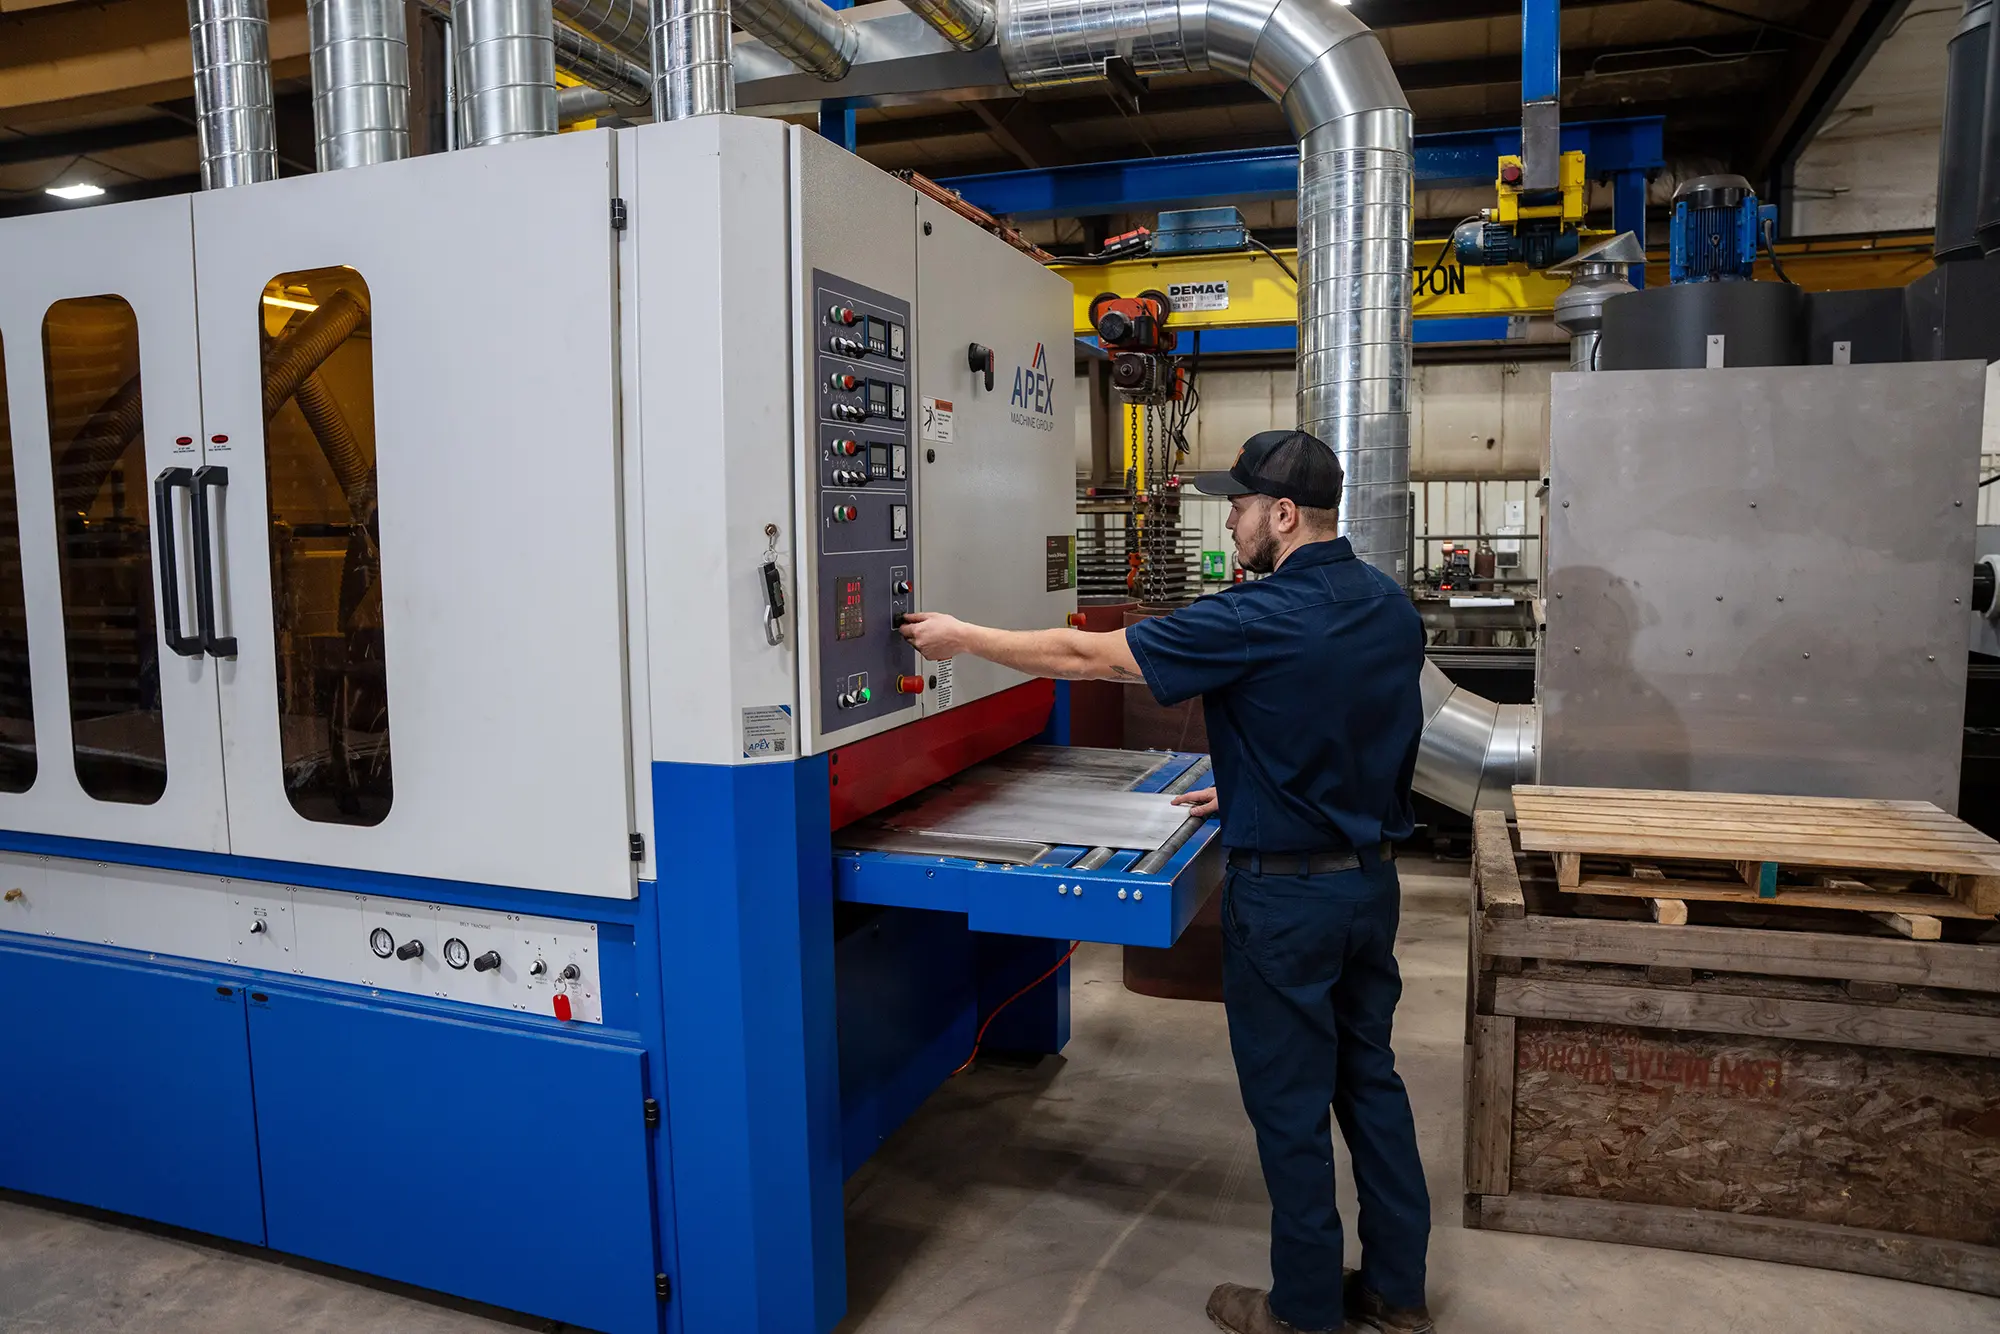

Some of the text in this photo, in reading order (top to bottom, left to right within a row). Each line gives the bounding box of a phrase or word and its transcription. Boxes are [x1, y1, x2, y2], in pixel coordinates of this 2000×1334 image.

[1413, 264, 1465, 296] TON
[1170, 284, 1225, 296] DEMAG
[822, 315, 827, 326] 4
[1011, 344, 1054, 416] APEX
[823, 382, 828, 394] 3
[1010, 412, 1054, 432] MACHINE GROUP
[824, 450, 829, 461] 2
[748, 738, 770, 751] APEX
